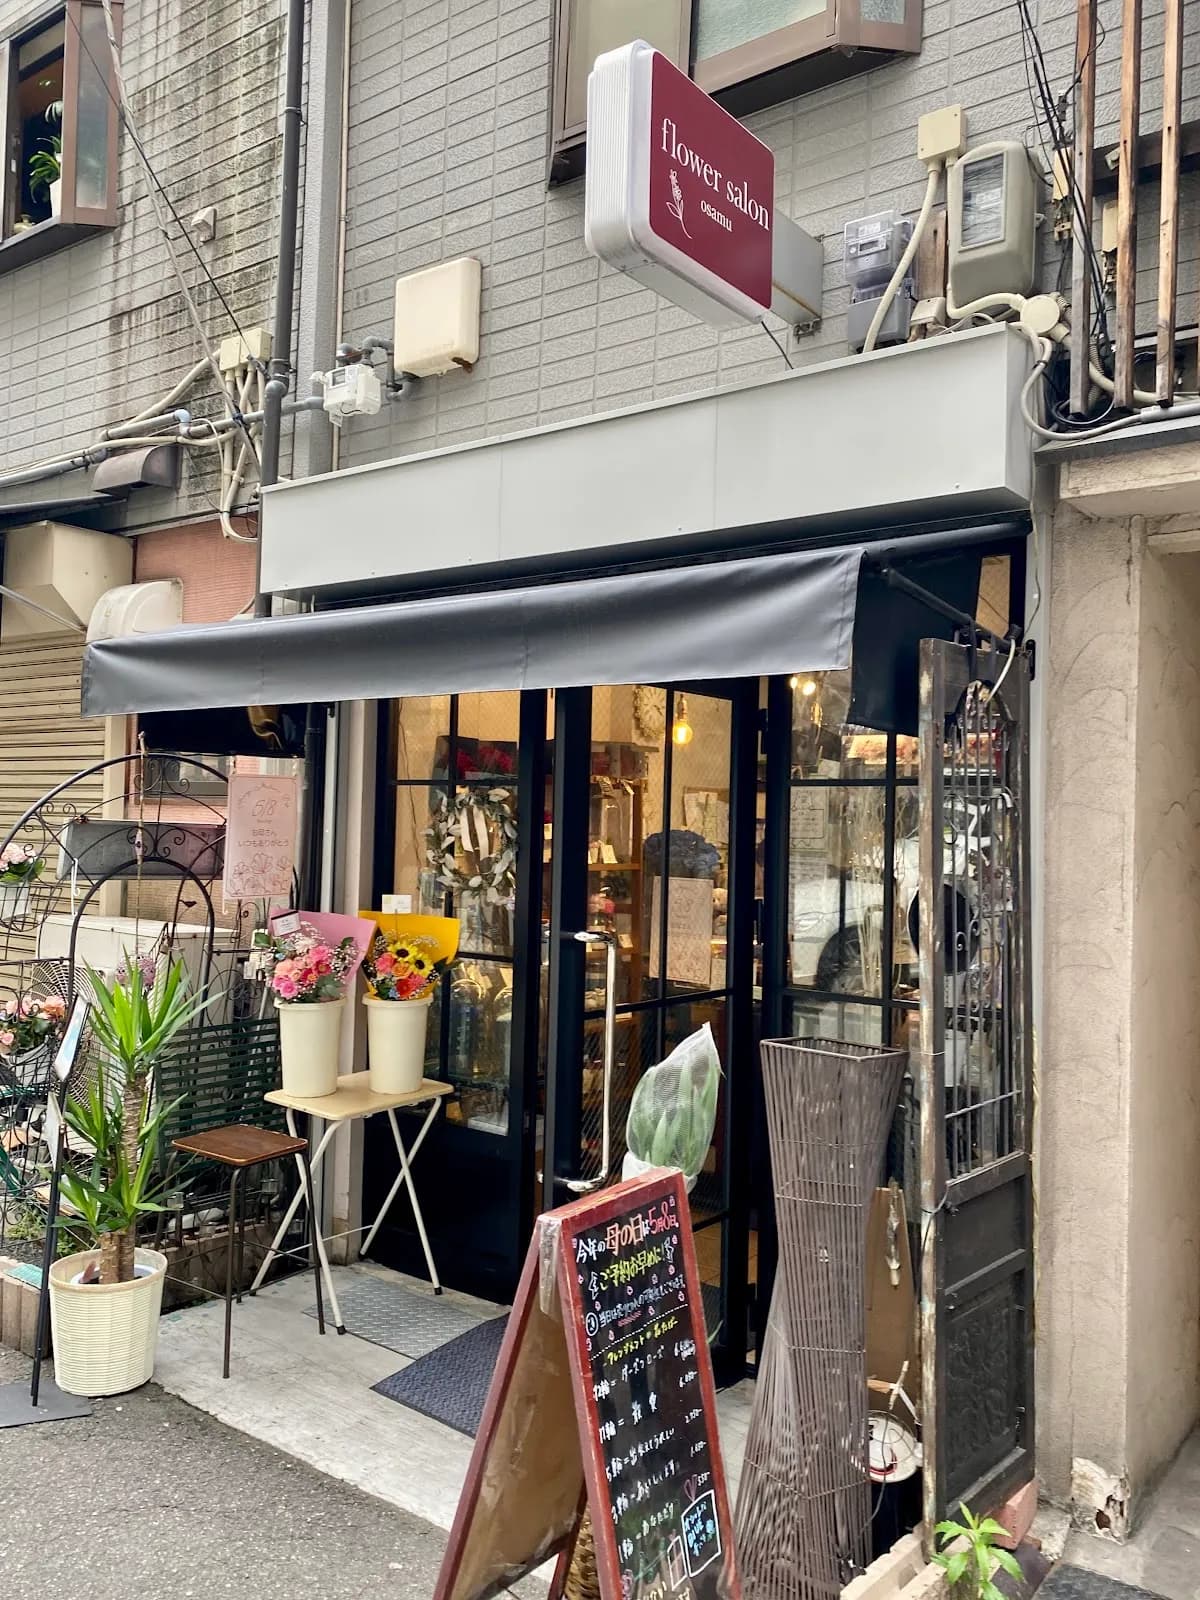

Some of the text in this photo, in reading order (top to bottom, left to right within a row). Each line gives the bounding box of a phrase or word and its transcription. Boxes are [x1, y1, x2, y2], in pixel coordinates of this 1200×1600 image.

[661, 118, 770, 231] flower salon
[700, 200, 733, 232] osamu
